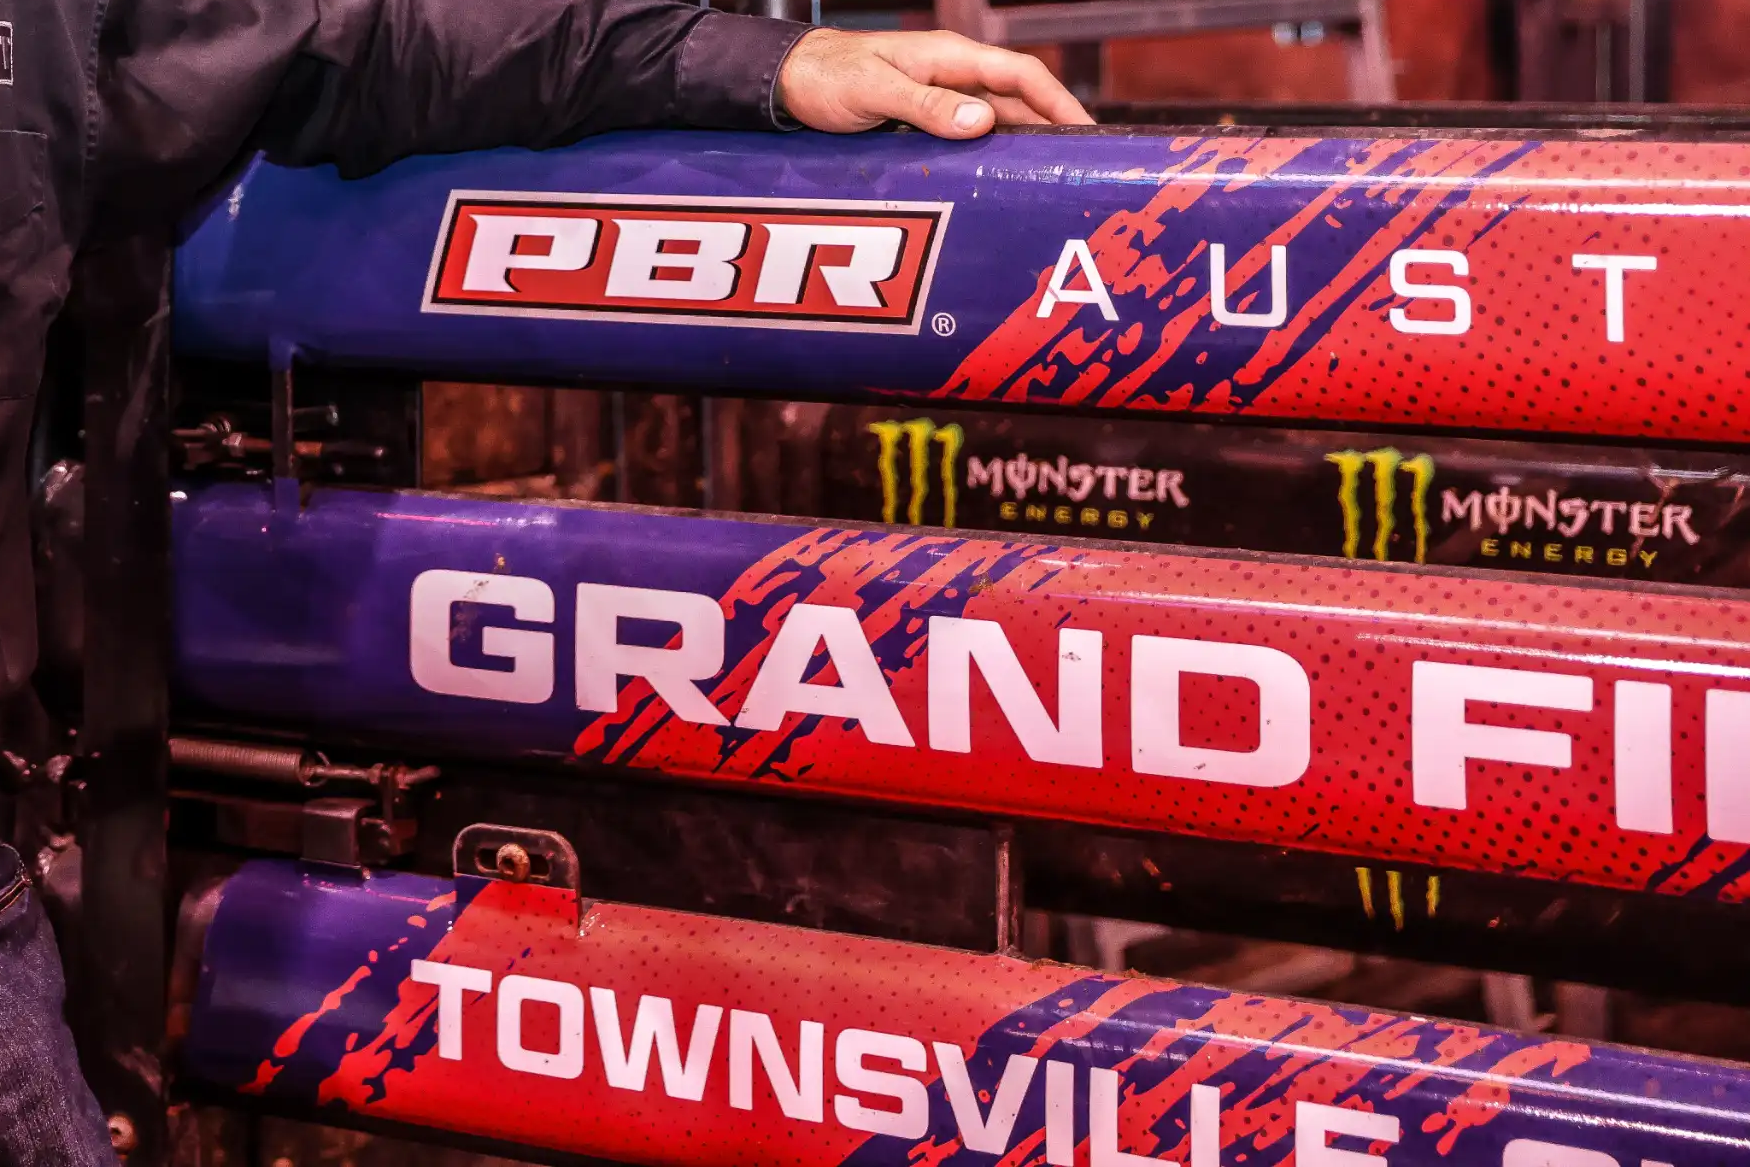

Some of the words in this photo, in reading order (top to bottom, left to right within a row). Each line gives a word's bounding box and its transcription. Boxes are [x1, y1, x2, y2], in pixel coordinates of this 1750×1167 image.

[462, 214, 909, 308] PBR
[967, 452, 1189, 507] MONSTER
[1000, 502, 1154, 530] ENERGY
[1441, 486, 1700, 544] MONSTER
[1480, 537, 1658, 568] ENERGY
[410, 568, 1311, 788] GRAND
